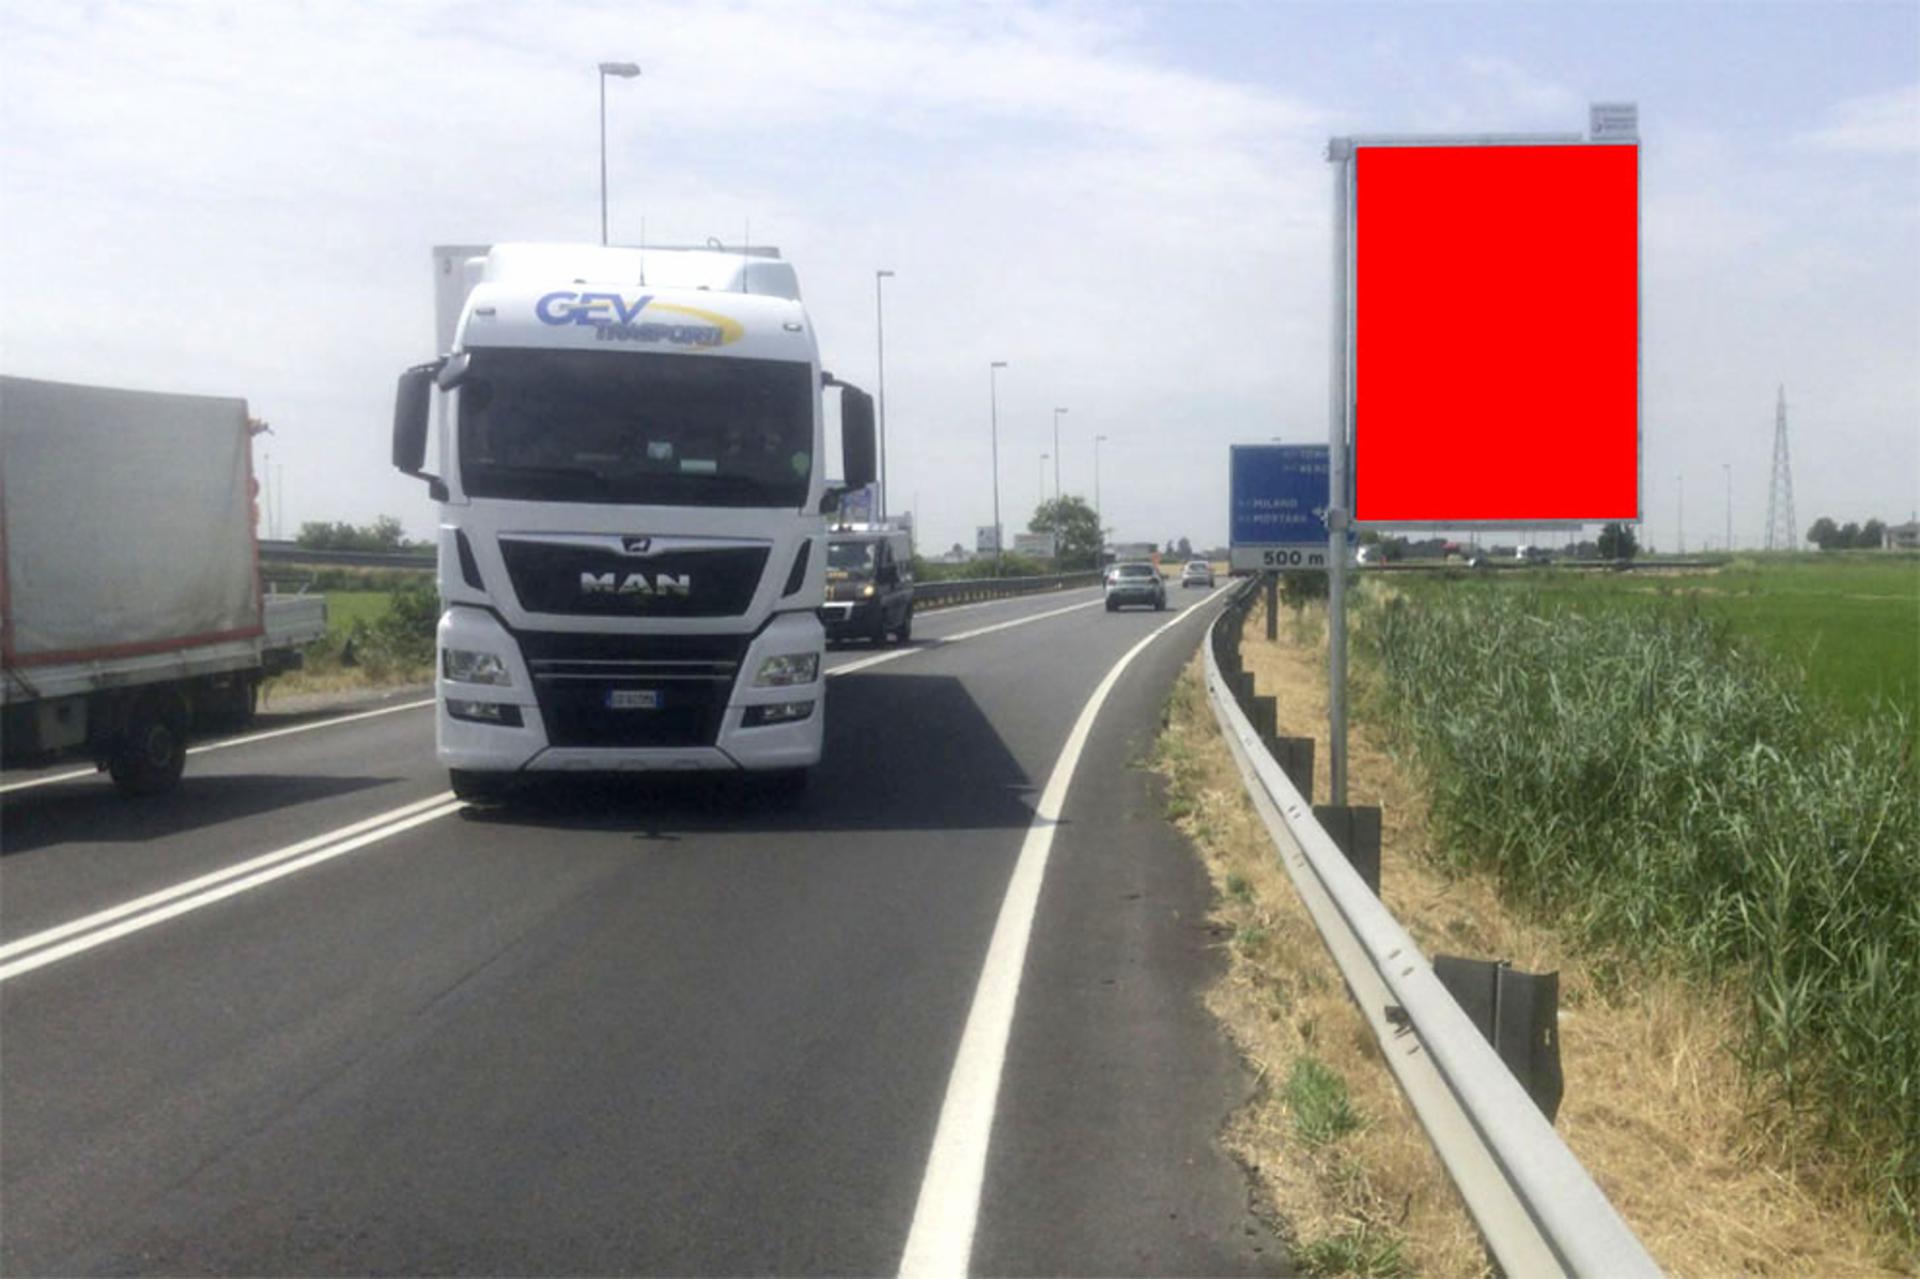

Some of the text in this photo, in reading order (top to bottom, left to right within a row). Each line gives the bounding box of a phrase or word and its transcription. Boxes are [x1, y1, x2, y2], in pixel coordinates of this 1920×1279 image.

[535, 291, 654, 326] GEV
[1263, 550, 1324, 566] 500 m
[580, 572, 691, 595] MAN
